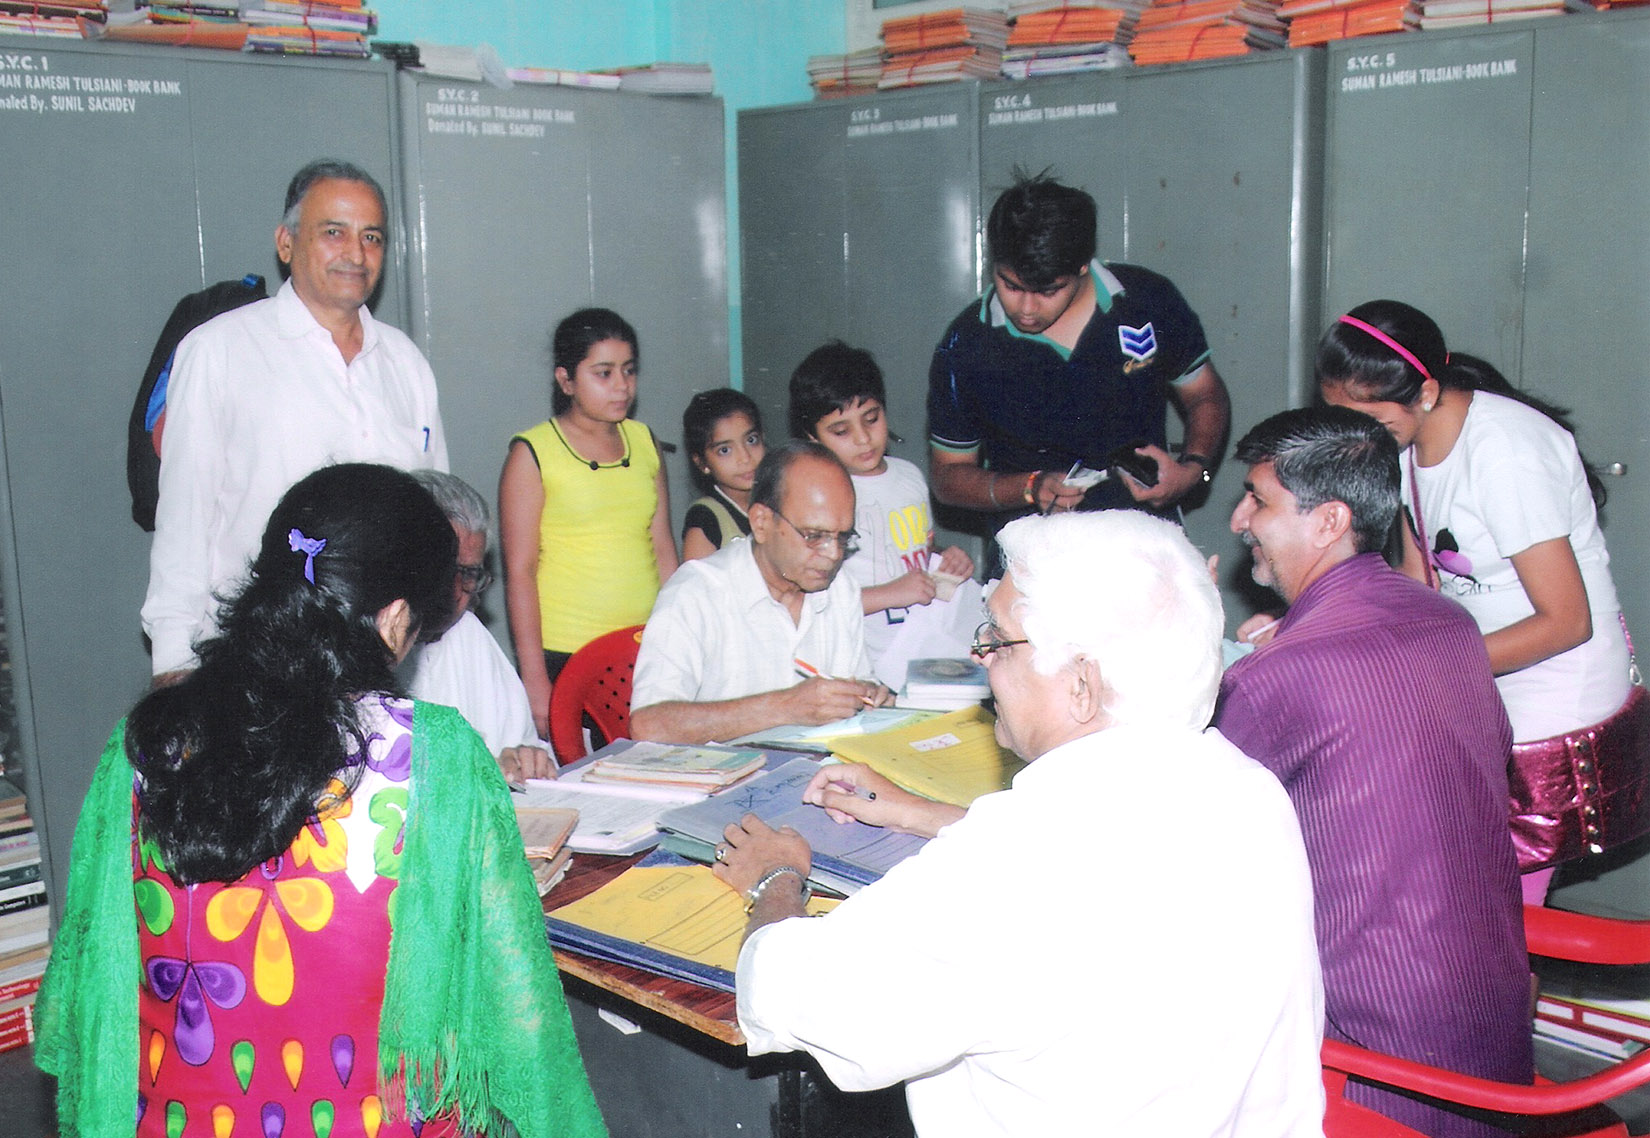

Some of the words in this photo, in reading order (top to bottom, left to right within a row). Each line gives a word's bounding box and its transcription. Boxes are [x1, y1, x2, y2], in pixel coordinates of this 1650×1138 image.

[1385, 52, 1396, 67] 5
[1341, 74, 1376, 91] SUMAN
[1378, 69, 1418, 87] RAMESH
[1490, 59, 1517, 76] BANK
[25, 74, 71, 91] RAMESH
[153, 80, 181, 95] BANK
[51, 95, 84, 112] SUNIL
[87, 96, 136, 113] SACHDEV
[470, 89, 480, 102] 2
